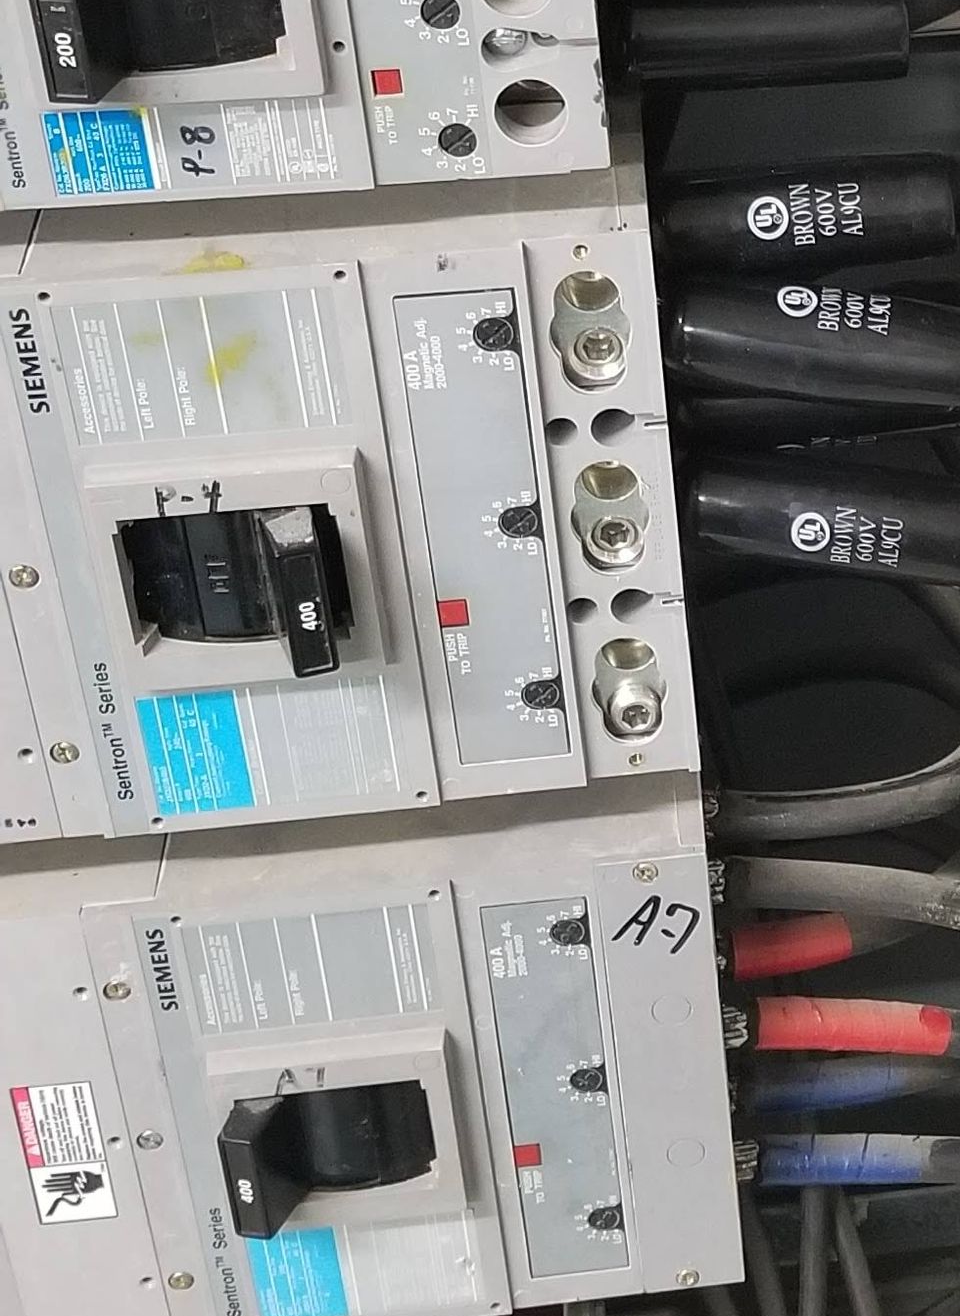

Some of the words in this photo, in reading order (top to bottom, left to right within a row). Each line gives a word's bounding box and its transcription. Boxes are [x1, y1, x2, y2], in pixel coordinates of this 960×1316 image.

[404, 18, 416, 28] 4
[419, 31, 431, 40] 3
[437, 35, 450, 44] 2
[456, 28, 470, 46] LO
[54, 33, 77, 68] 200
[384, 105, 396, 128] TRIP
[428, 111, 441, 121] 6
[446, 108, 459, 116] 7
[466, 104, 479, 118] HI
[374, 106, 385, 133] PUSH
[388, 131, 398, 145] TO
[418, 127, 430, 136] 5
[421, 147, 432, 156] 4
[436, 160, 448, 169] 3
[454, 164, 466, 172] 2
[472, 157, 485, 174] LO
[788, 183, 816, 246] BROWN
[814, 188, 838, 236] 600V
[837, 183, 864, 235] AL9CU
[480, 307, 492, 316] 7
[494, 301, 506, 314] HI
[844, 292, 865, 328] 600V
[465, 312, 476, 320] 6
[458, 344, 468, 352] 4
[9, 308, 50, 413] SIEMENS
[404, 350, 418, 362] A
[430, 335, 447, 389] 2000-4000
[489, 358, 499, 366] 2
[419, 342, 434, 389] Magnetic
[503, 357, 514, 371] LO
[406, 364, 422, 390] 400
[74, 368, 96, 434] Accessories
[139, 408, 154, 429] Left
[181, 396, 196, 426] Right
[507, 497, 517, 505] 7
[520, 491, 532, 503] HI
[492, 501, 503, 509] 6
[481, 515, 492, 523] 5
[484, 530, 494, 538] 4
[830, 505, 857, 563] BROWN
[855, 516, 877, 562] 600V
[497, 541, 507, 549] 3
[513, 542, 523, 550] 2
[527, 542, 538, 555] LO
[878, 516, 904, 568] AL9CU
[299, 602, 317, 631] 400
[444, 634, 458, 662] PUSH
[457, 633, 470, 657] TRIP
[461, 660, 471, 675] TO
[93, 662, 115, 715] Series
[489, 946, 503, 956] A
[145, 929, 179, 1011] SIEMENS
[492, 957, 506, 978] 400
[238, 1179, 254, 1203] 400
[208, 1208, 228, 1249] Series
